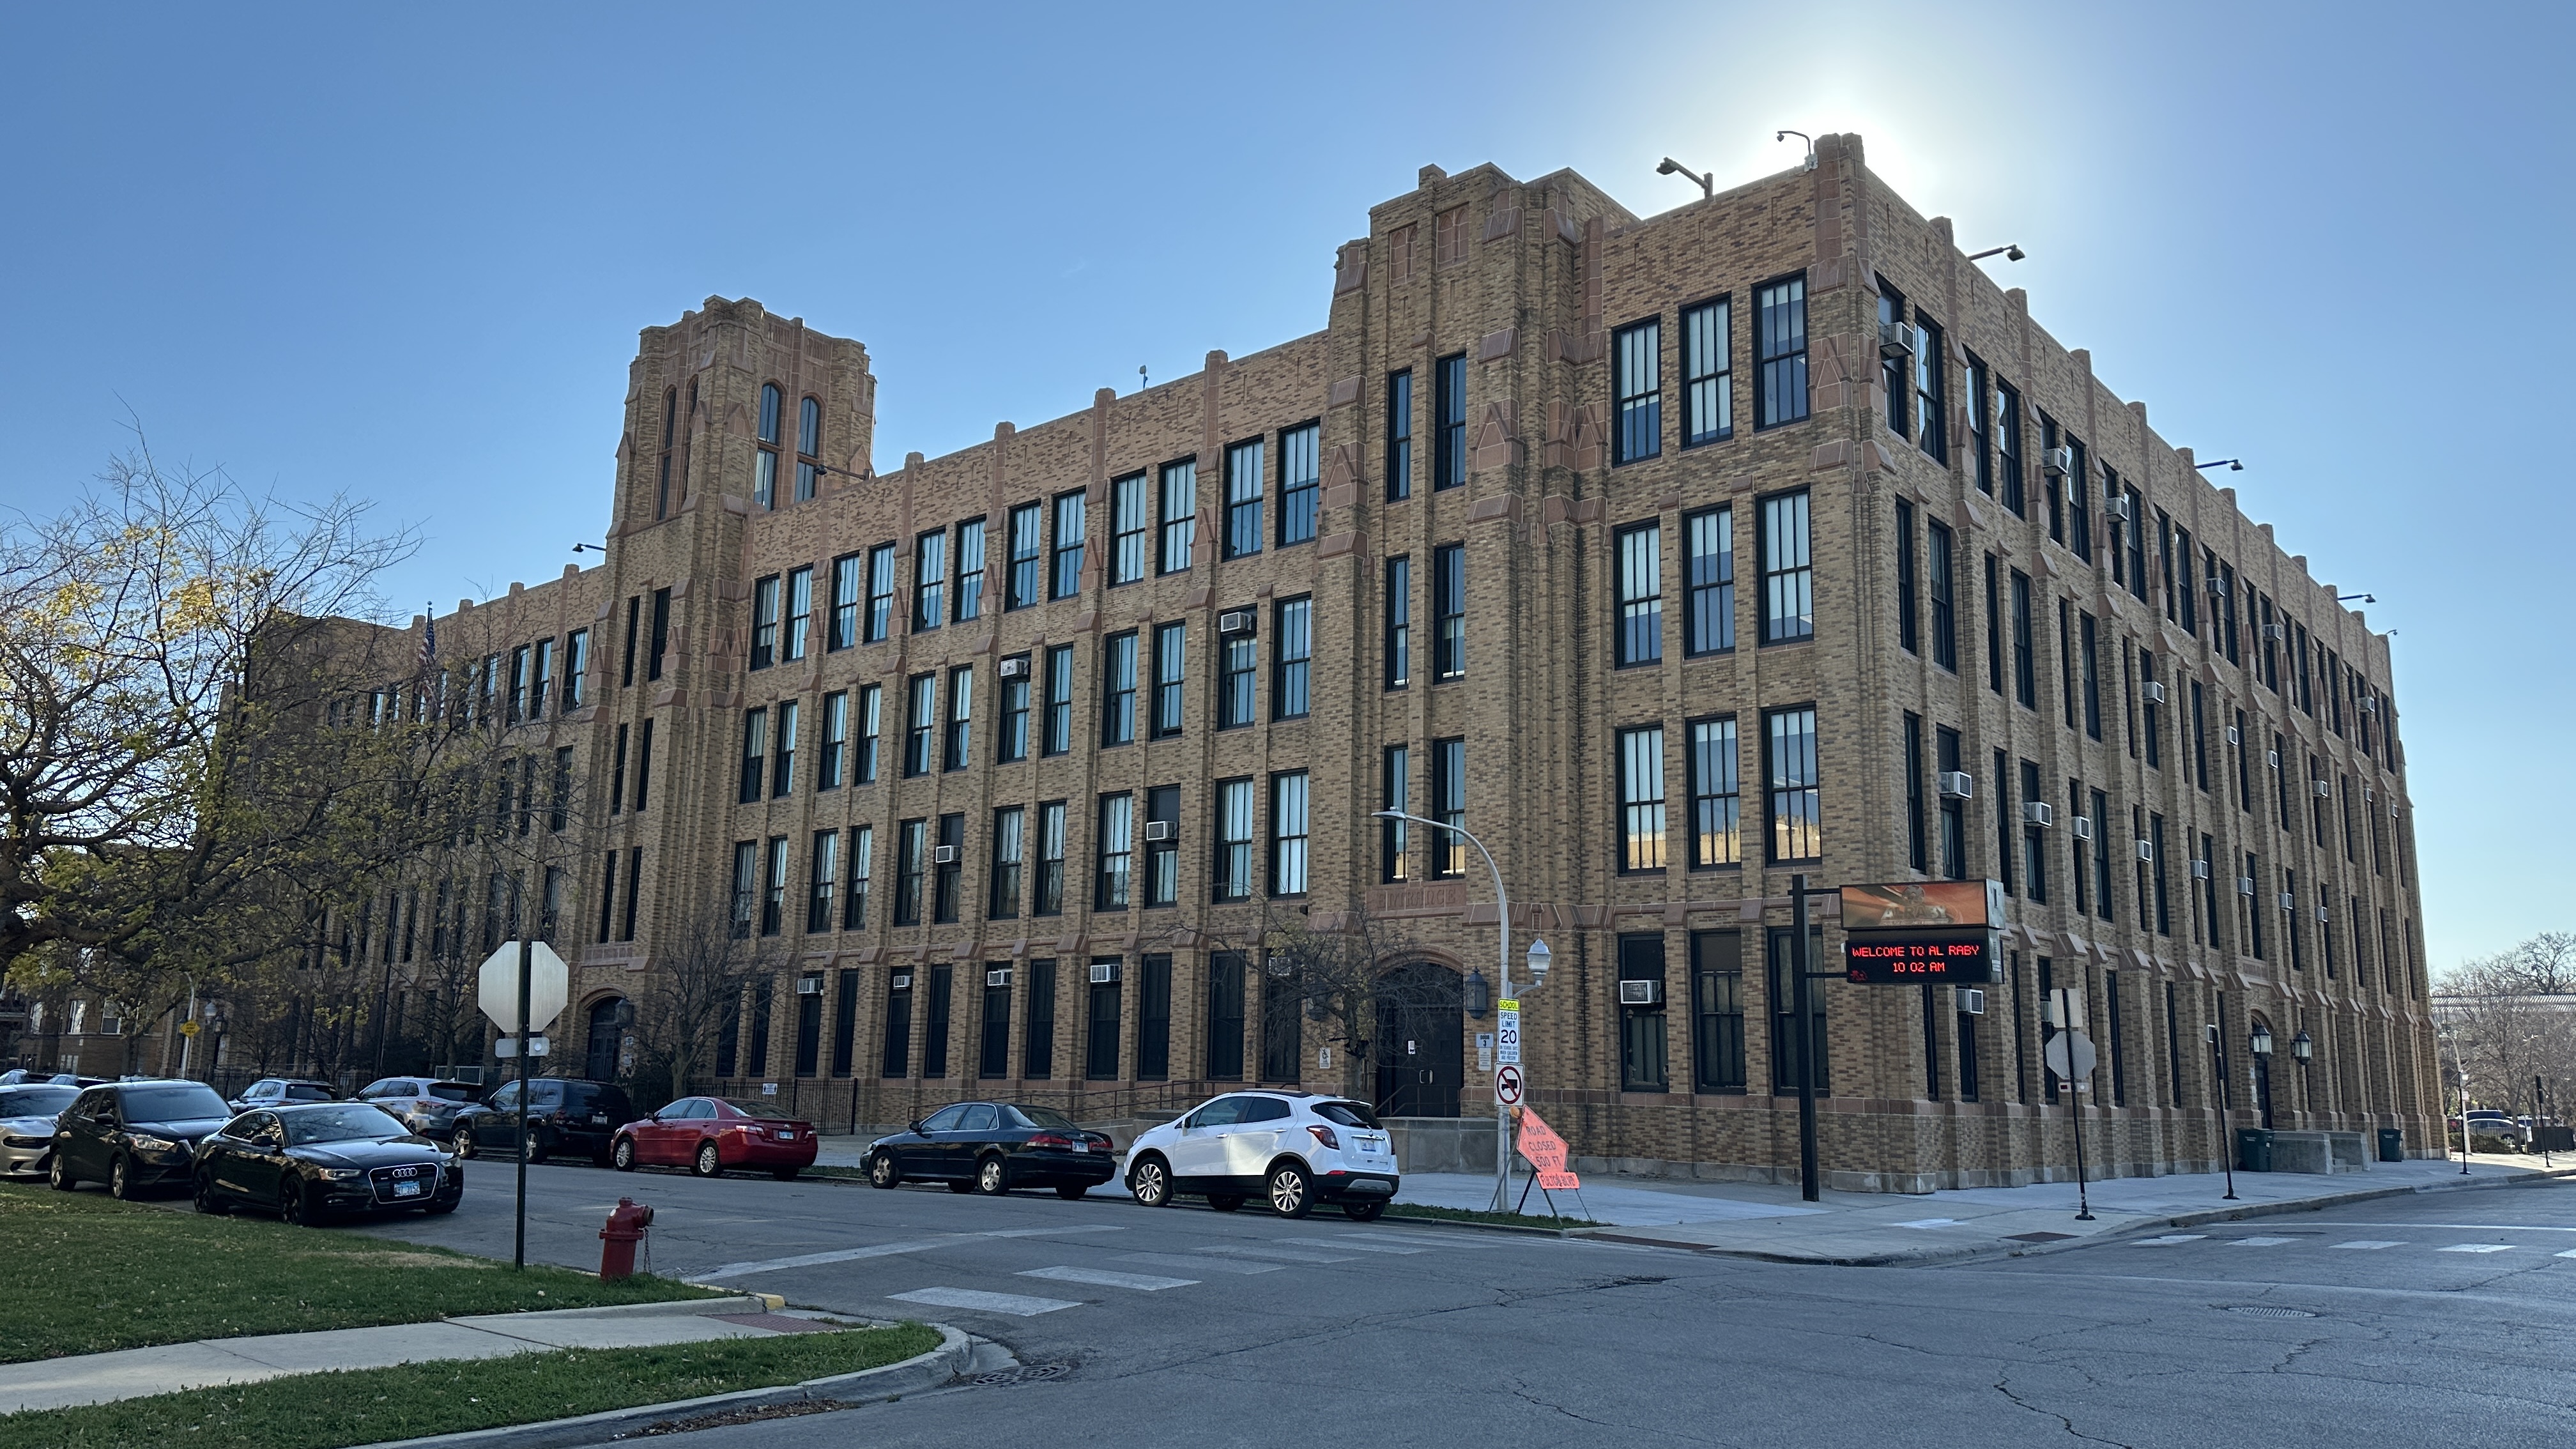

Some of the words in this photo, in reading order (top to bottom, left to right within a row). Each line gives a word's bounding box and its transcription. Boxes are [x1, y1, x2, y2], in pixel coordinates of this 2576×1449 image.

[1377, 889, 1455, 908] ENTRANCE
[1851, 946, 1905, 957] WELCOME
[1909, 946, 1924, 956] TO
[1928, 946, 1944, 956] AL
[1948, 945, 1980, 956] RABY
[1892, 962, 1906, 972] 10
[1910, 962, 1926, 972] 02
[1929, 962, 1945, 972] AM
[1499, 1001, 1518, 1009] SCHOOL
[1501, 1012, 1517, 1020] SPEED
[1501, 1029, 1517, 1044] 20
[1526, 1126, 1546, 1136] ROAD
[1528, 1140, 1556, 1152] CLOSED
[1535, 1156, 1551, 1167] 500
[1552, 1156, 1561, 1167] FT
